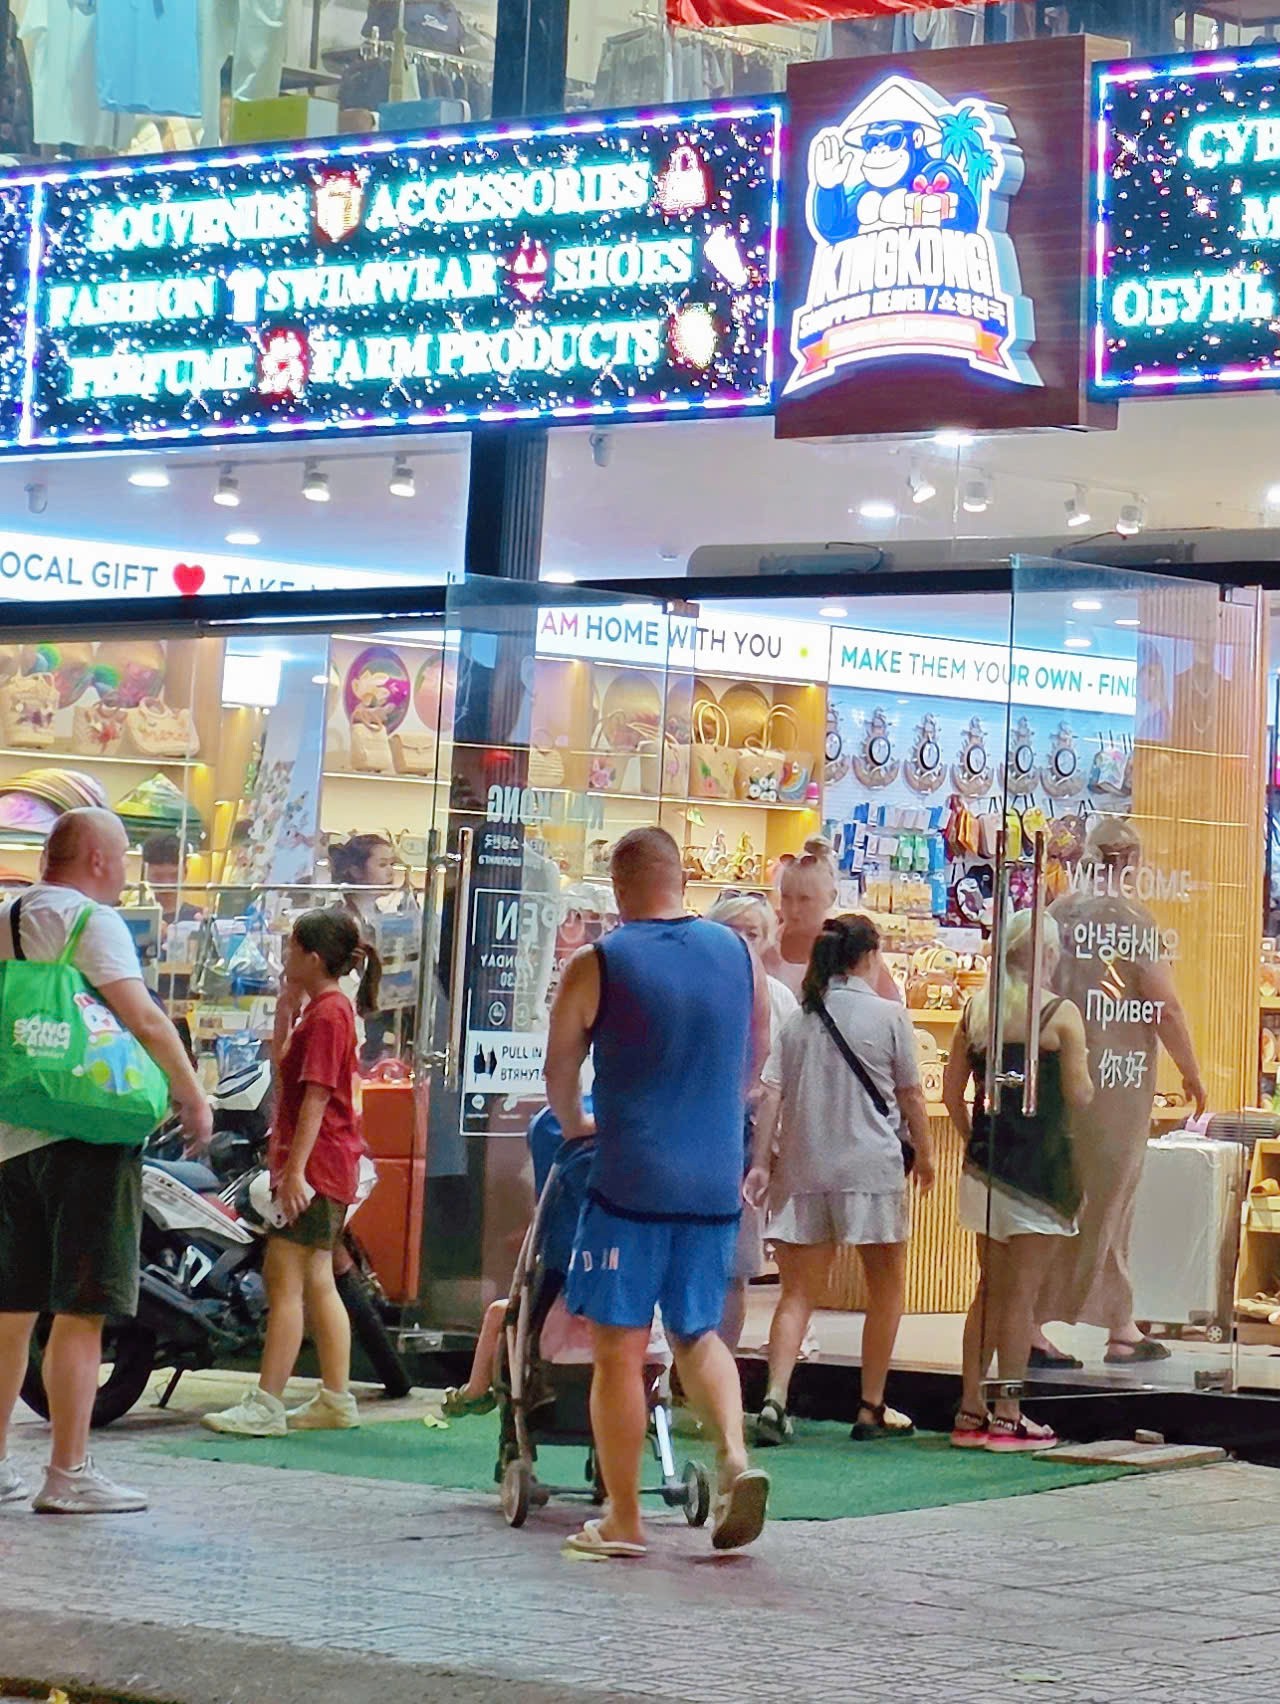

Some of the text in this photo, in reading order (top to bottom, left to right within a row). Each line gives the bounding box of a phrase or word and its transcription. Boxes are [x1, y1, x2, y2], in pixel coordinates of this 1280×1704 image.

[365, 161, 651, 232] ACCESSORIES
[49, 238, 693, 328] FASHION SWIMWEAR SHOES
[809, 226, 995, 306] KINGKONG
[1111, 274, 1274, 327] ОБУВЬ
[309, 333, 433, 384] FARM
[436, 319, 662, 375] PRODUCTS
[92, 561, 158, 592] GIFT
[540, 610, 782, 659] AM HOME WITH YOU
[841, 645, 903, 674] MAKE
[909, 652, 966, 680] THEM
[974, 659, 1029, 687] YOUR
[1035, 666, 1083, 692] OWN
[1066, 861, 1192, 899] WELCOME
[1073, 921, 1183, 963] 안녕하세요
[1086, 988, 1166, 1031] Привет
[502, 1046, 528, 1059] PULL
[1098, 1048, 1149, 1089] 你好
